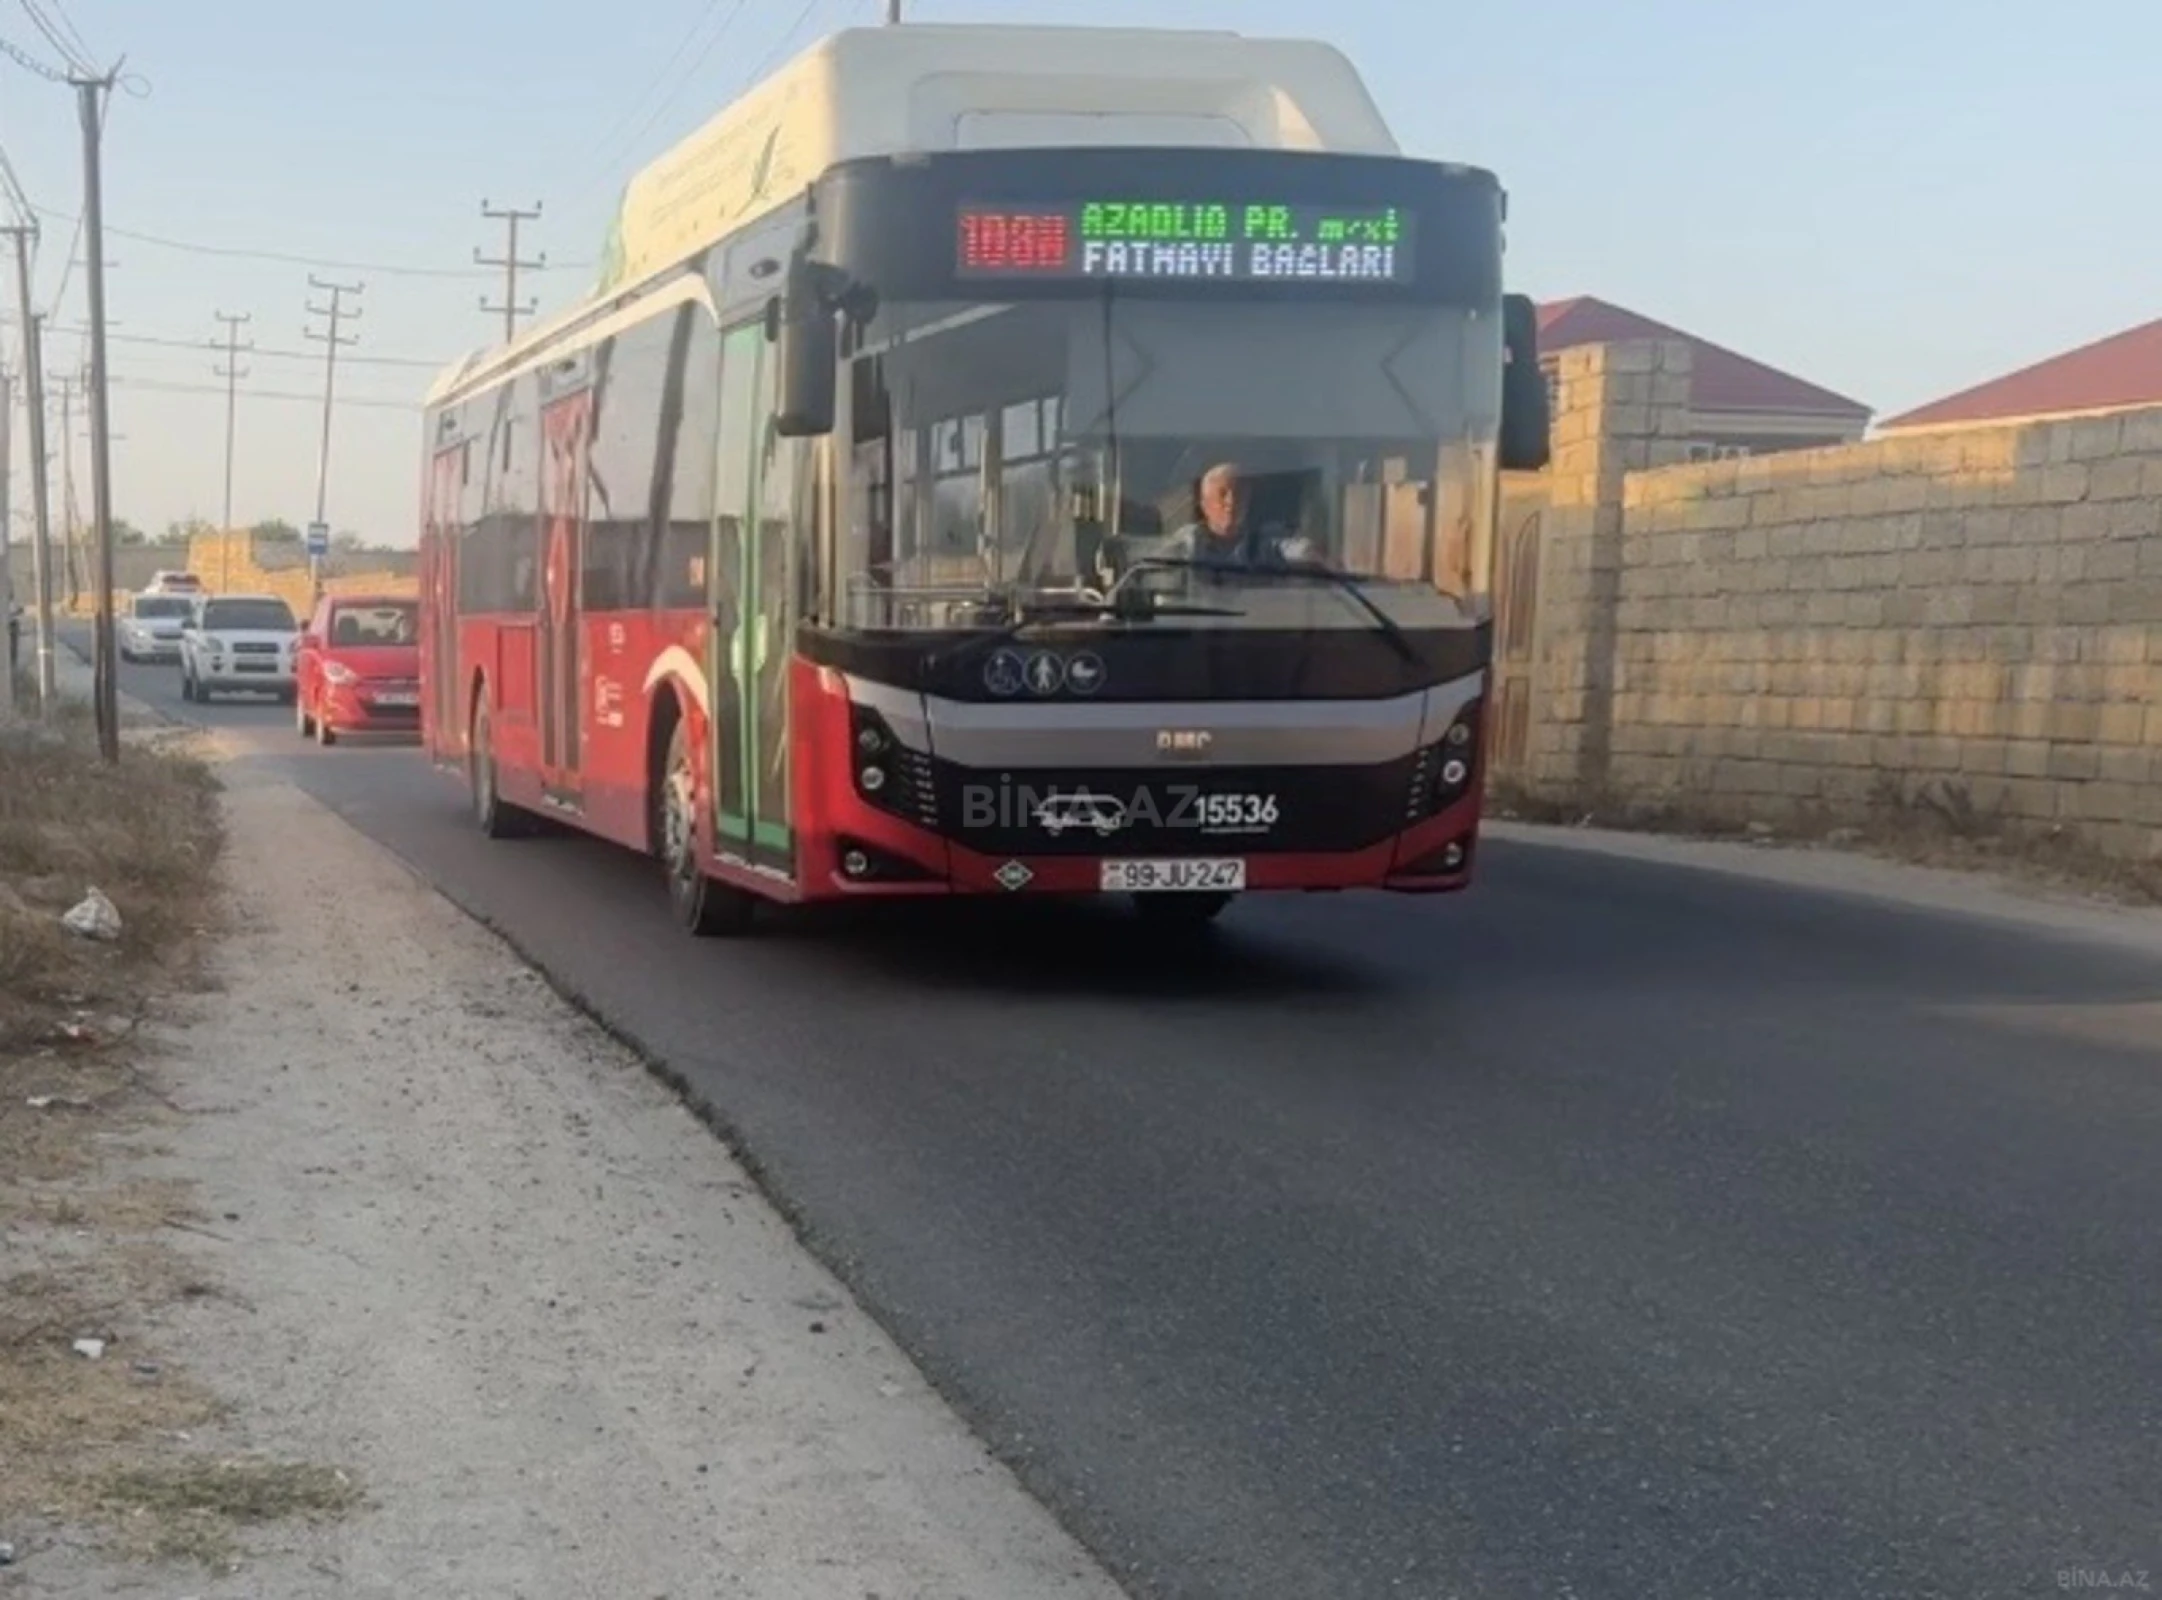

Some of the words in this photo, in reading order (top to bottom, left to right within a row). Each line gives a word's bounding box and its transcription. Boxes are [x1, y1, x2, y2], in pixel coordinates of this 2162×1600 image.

[1245, 205, 1299, 239] PR.
[1084, 241, 1233, 276] FATMAYI
[1194, 793, 1280, 824] 15536
[1124, 861, 1239, 887] 99-JU-247
